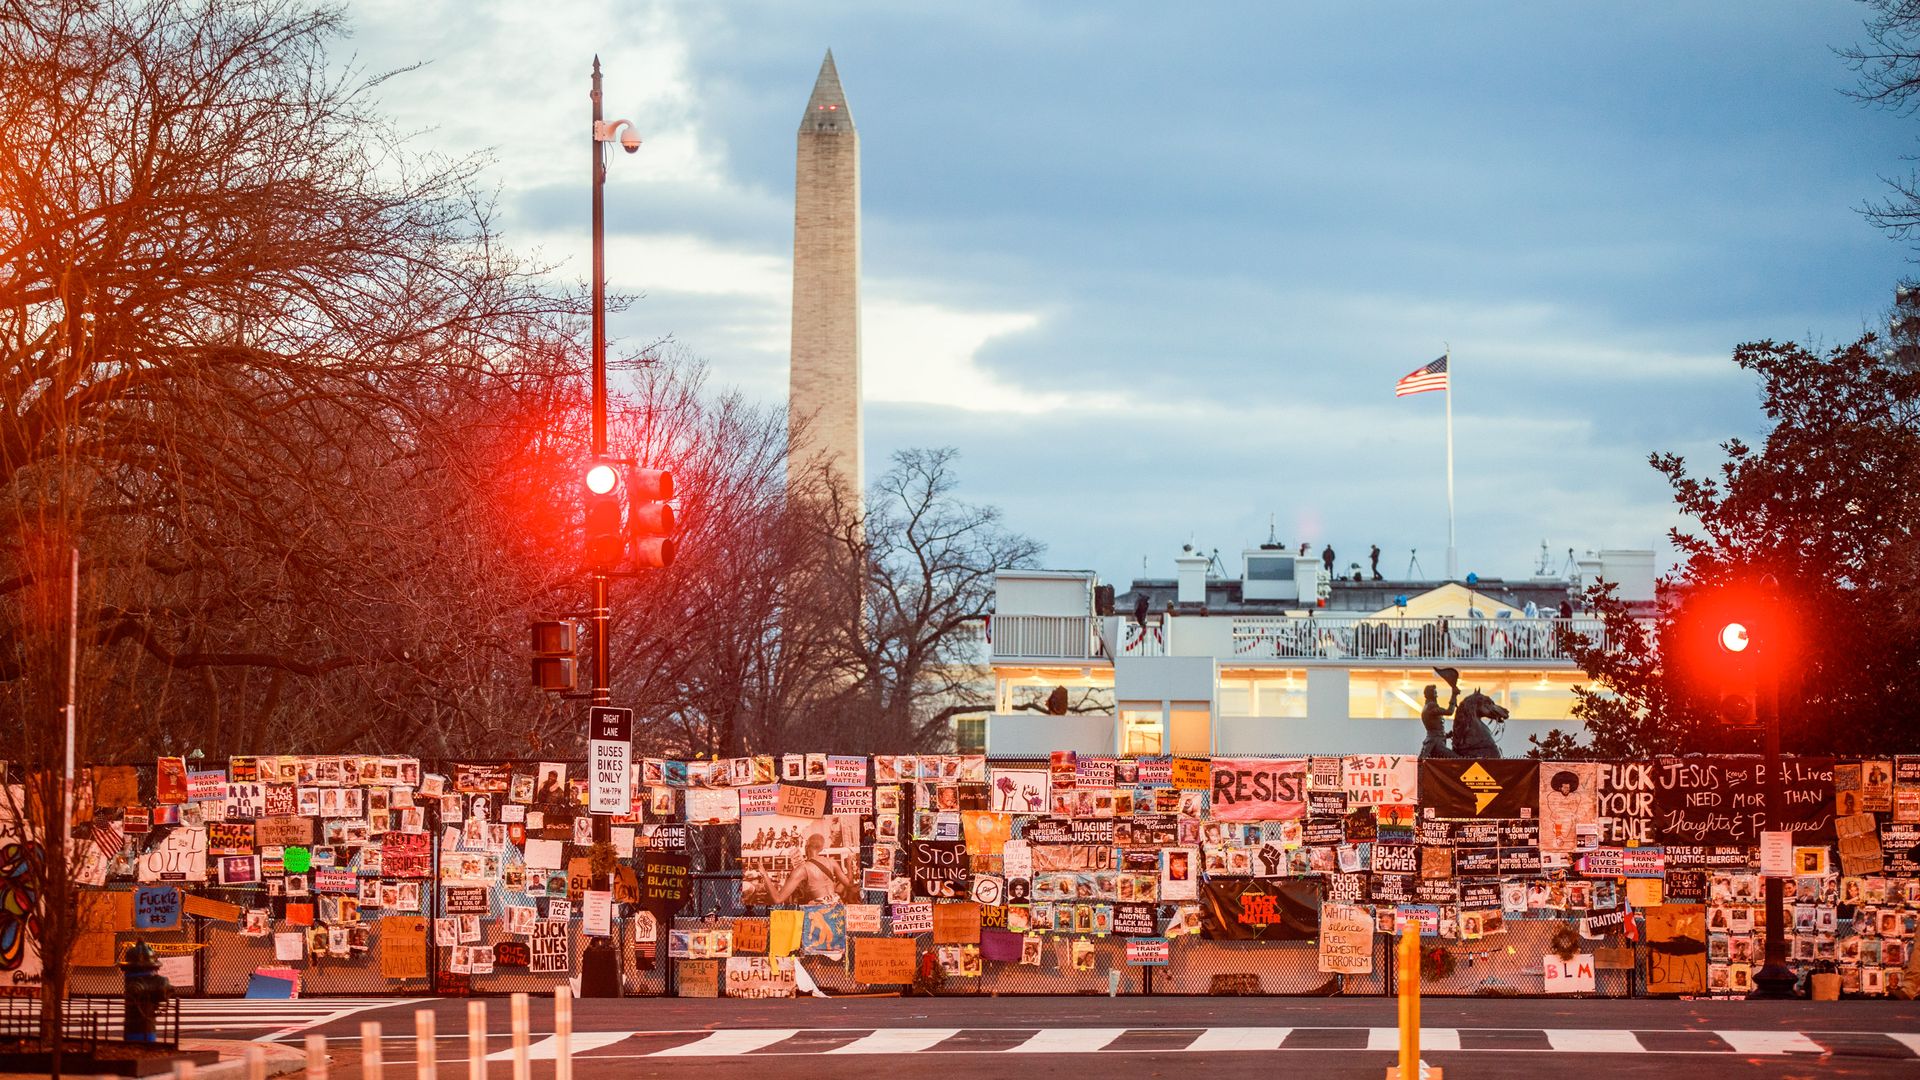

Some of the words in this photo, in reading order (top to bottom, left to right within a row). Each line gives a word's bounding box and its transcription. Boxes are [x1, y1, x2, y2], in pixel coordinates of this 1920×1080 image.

[603, 714, 620, 724] RIGHT
[603, 727, 618, 737] LANE
[598, 746, 623, 758] BUSES
[598, 759, 623, 772] BIKES
[598, 772, 622, 783] ONLY
[1315, 774, 1339, 786] QUIET.
[1598, 764, 1655, 790] FUCK
[1660, 763, 1719, 790] JESUS
[1796, 762, 1833, 781] Lives
[266, 786, 292, 796] BLACK
[600, 787, 622, 796] 7AM-7PM
[790, 787, 816, 798] BLACK
[1211, 770, 1305, 805] RESIST
[837, 790, 870, 798] BLACK
[1686, 792, 1722, 807] NEED
[1732, 793, 1766, 808] MOR
[1784, 789, 1822, 804] THAN
[267, 800, 292, 808] LIVES
[600, 798, 620, 806] MON-SAT
[788, 797, 814, 808] LIVES
[1598, 793, 1654, 817] YOUR
[227, 805, 263, 817] BLUE
[268, 806, 297, 816] MATTER
[783, 804, 815, 816] MATTER
[1072, 822, 1112, 832] IMAGINE
[1422, 822, 1450, 830] DEFEAT
[1598, 818, 1654, 842] FENCE
[1662, 810, 1730, 840] Thoughts
[212, 826, 250, 837] FUCK
[1030, 828, 1066, 836] SUPREMACY
[1072, 832, 1112, 842] JUSTICE
[1424, 830, 1447, 838] WHITE
[211, 837, 253, 850] RACISM
[1416, 836, 1456, 846] SUPREMACY
[918, 843, 966, 865] STOP
[1377, 846, 1415, 858] BLACK
[1666, 847, 1690, 855] STATE
[1692, 847, 1703, 855] OF
[148, 850, 202, 873] OUT
[1664, 855, 1706, 864] INJUSTICE
[1706, 856, 1749, 864] EMERGENCY
[648, 864, 686, 876] DEFEND
[1376, 859, 1416, 872] POWER
[915, 866, 967, 880] KILLING
[1331, 874, 1359, 882] FUCK
[648, 876, 684, 888] BLACK
[1332, 882, 1360, 892] YOUR
[648, 888, 681, 900] LIVES
[927, 881, 955, 896] US
[1672, 888, 1702, 896] MATTER
[1241, 896, 1278, 905] BLACK
[1328, 892, 1361, 900] FENCE
[1372, 893, 1412, 901] SUPREMACY
[896, 905, 930, 914] BLACK
[980, 904, 1008, 917] JUST
[1245, 904, 1274, 914] LIVES
[1324, 907, 1355, 920] WHITE
[901, 914, 927, 922] LIVES
[981, 917, 1007, 926] LOVE
[1238, 914, 1280, 924] MATTER
[389, 920, 416, 932] SAY
[532, 922, 566, 938] BLACK
[894, 922, 931, 931] MATTER
[1116, 926, 1152, 934] MURDERED
[1328, 922, 1364, 932] silence
[1324, 933, 1346, 944] FUELS
[386, 938, 420, 953] THEIR
[532, 939, 567, 954] LIVES
[1326, 946, 1363, 955] DOMESTIC
[386, 956, 424, 974] NAMES
[532, 954, 568, 971] MATTER
[1322, 955, 1368, 967] TERRORISM
[1548, 963, 1592, 979] BLM
[1649, 950, 1703, 989] BLM
